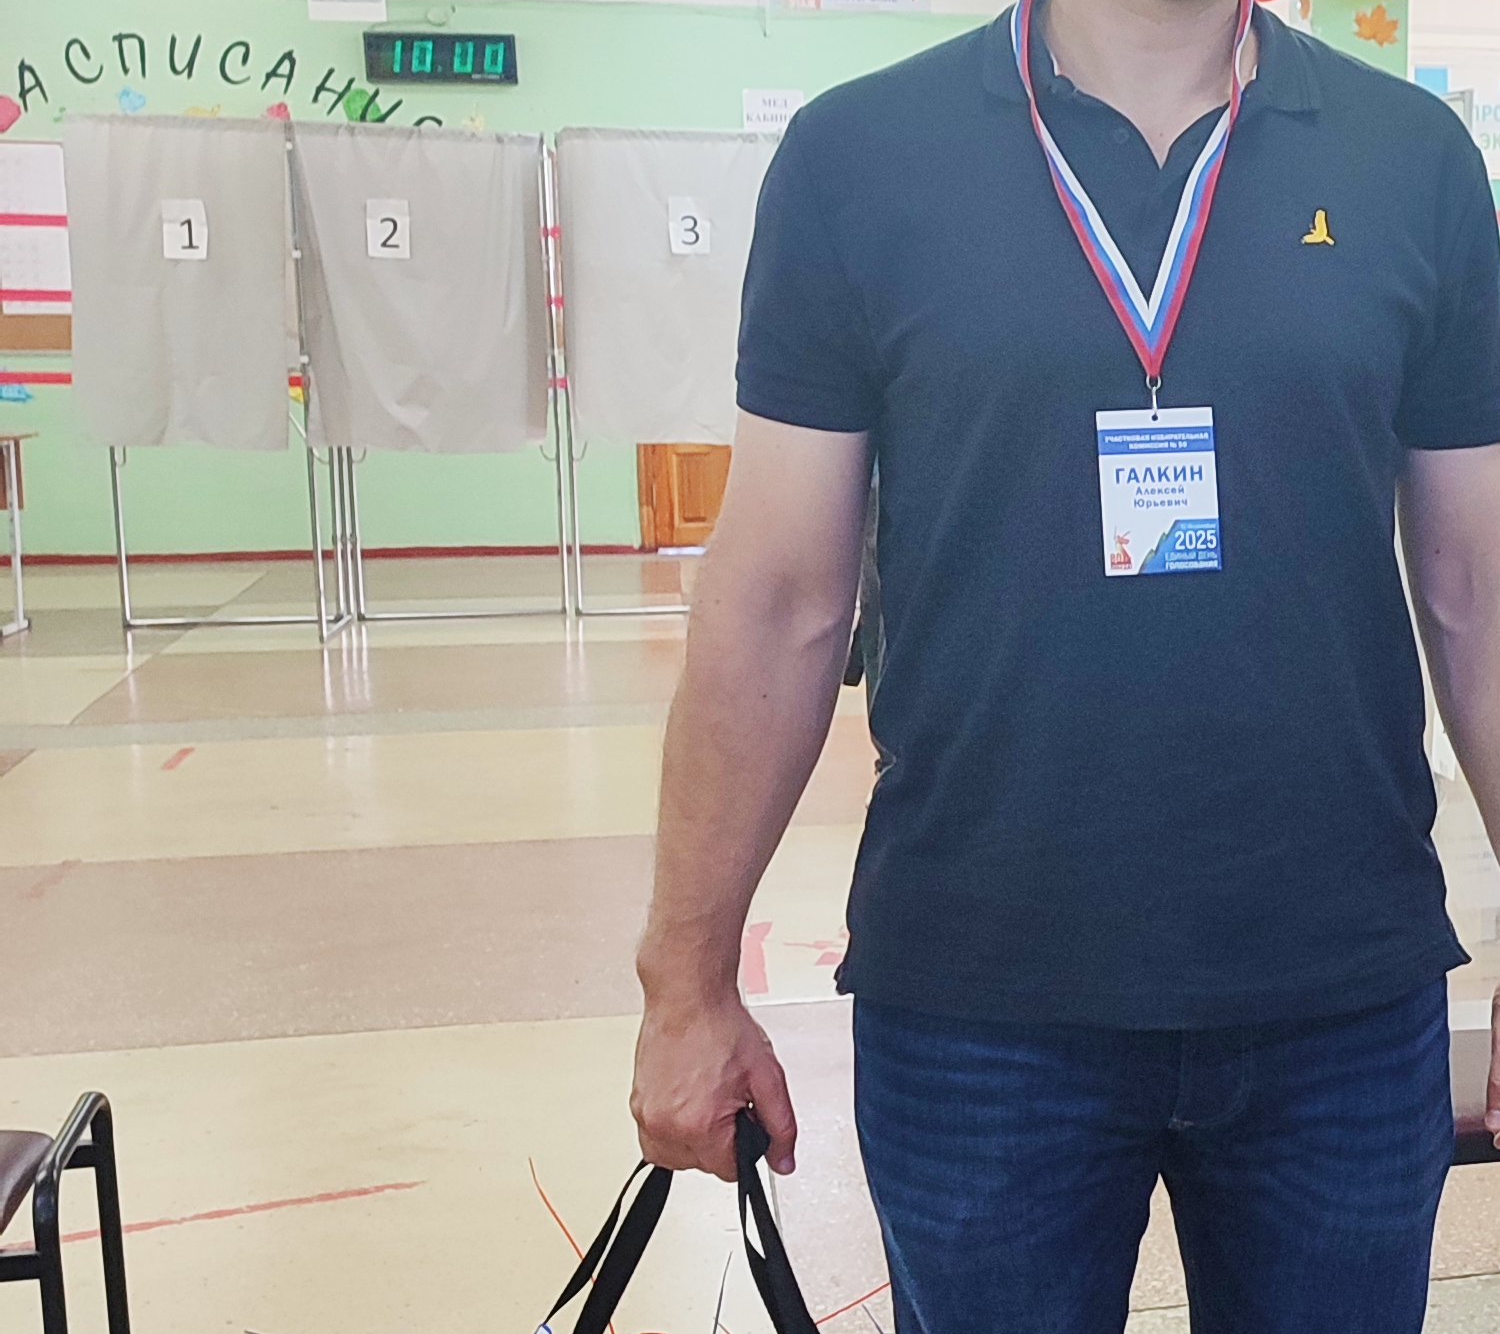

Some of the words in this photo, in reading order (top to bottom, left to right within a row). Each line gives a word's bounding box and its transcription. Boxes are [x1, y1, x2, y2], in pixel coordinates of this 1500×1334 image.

[17, 32, 442, 127] АСПИСАНИ
[746, 113, 790, 123] КАБИН
[180, 218, 200, 250] 1
[379, 217, 400, 249] 2
[680, 215, 700, 247] 3
[1115, 465, 1203, 484] ГАЛКИН
[1135, 484, 1185, 496] Алексей
[1134, 498, 1189, 510] Юрьевич
[1175, 530, 1217, 549] 2025
